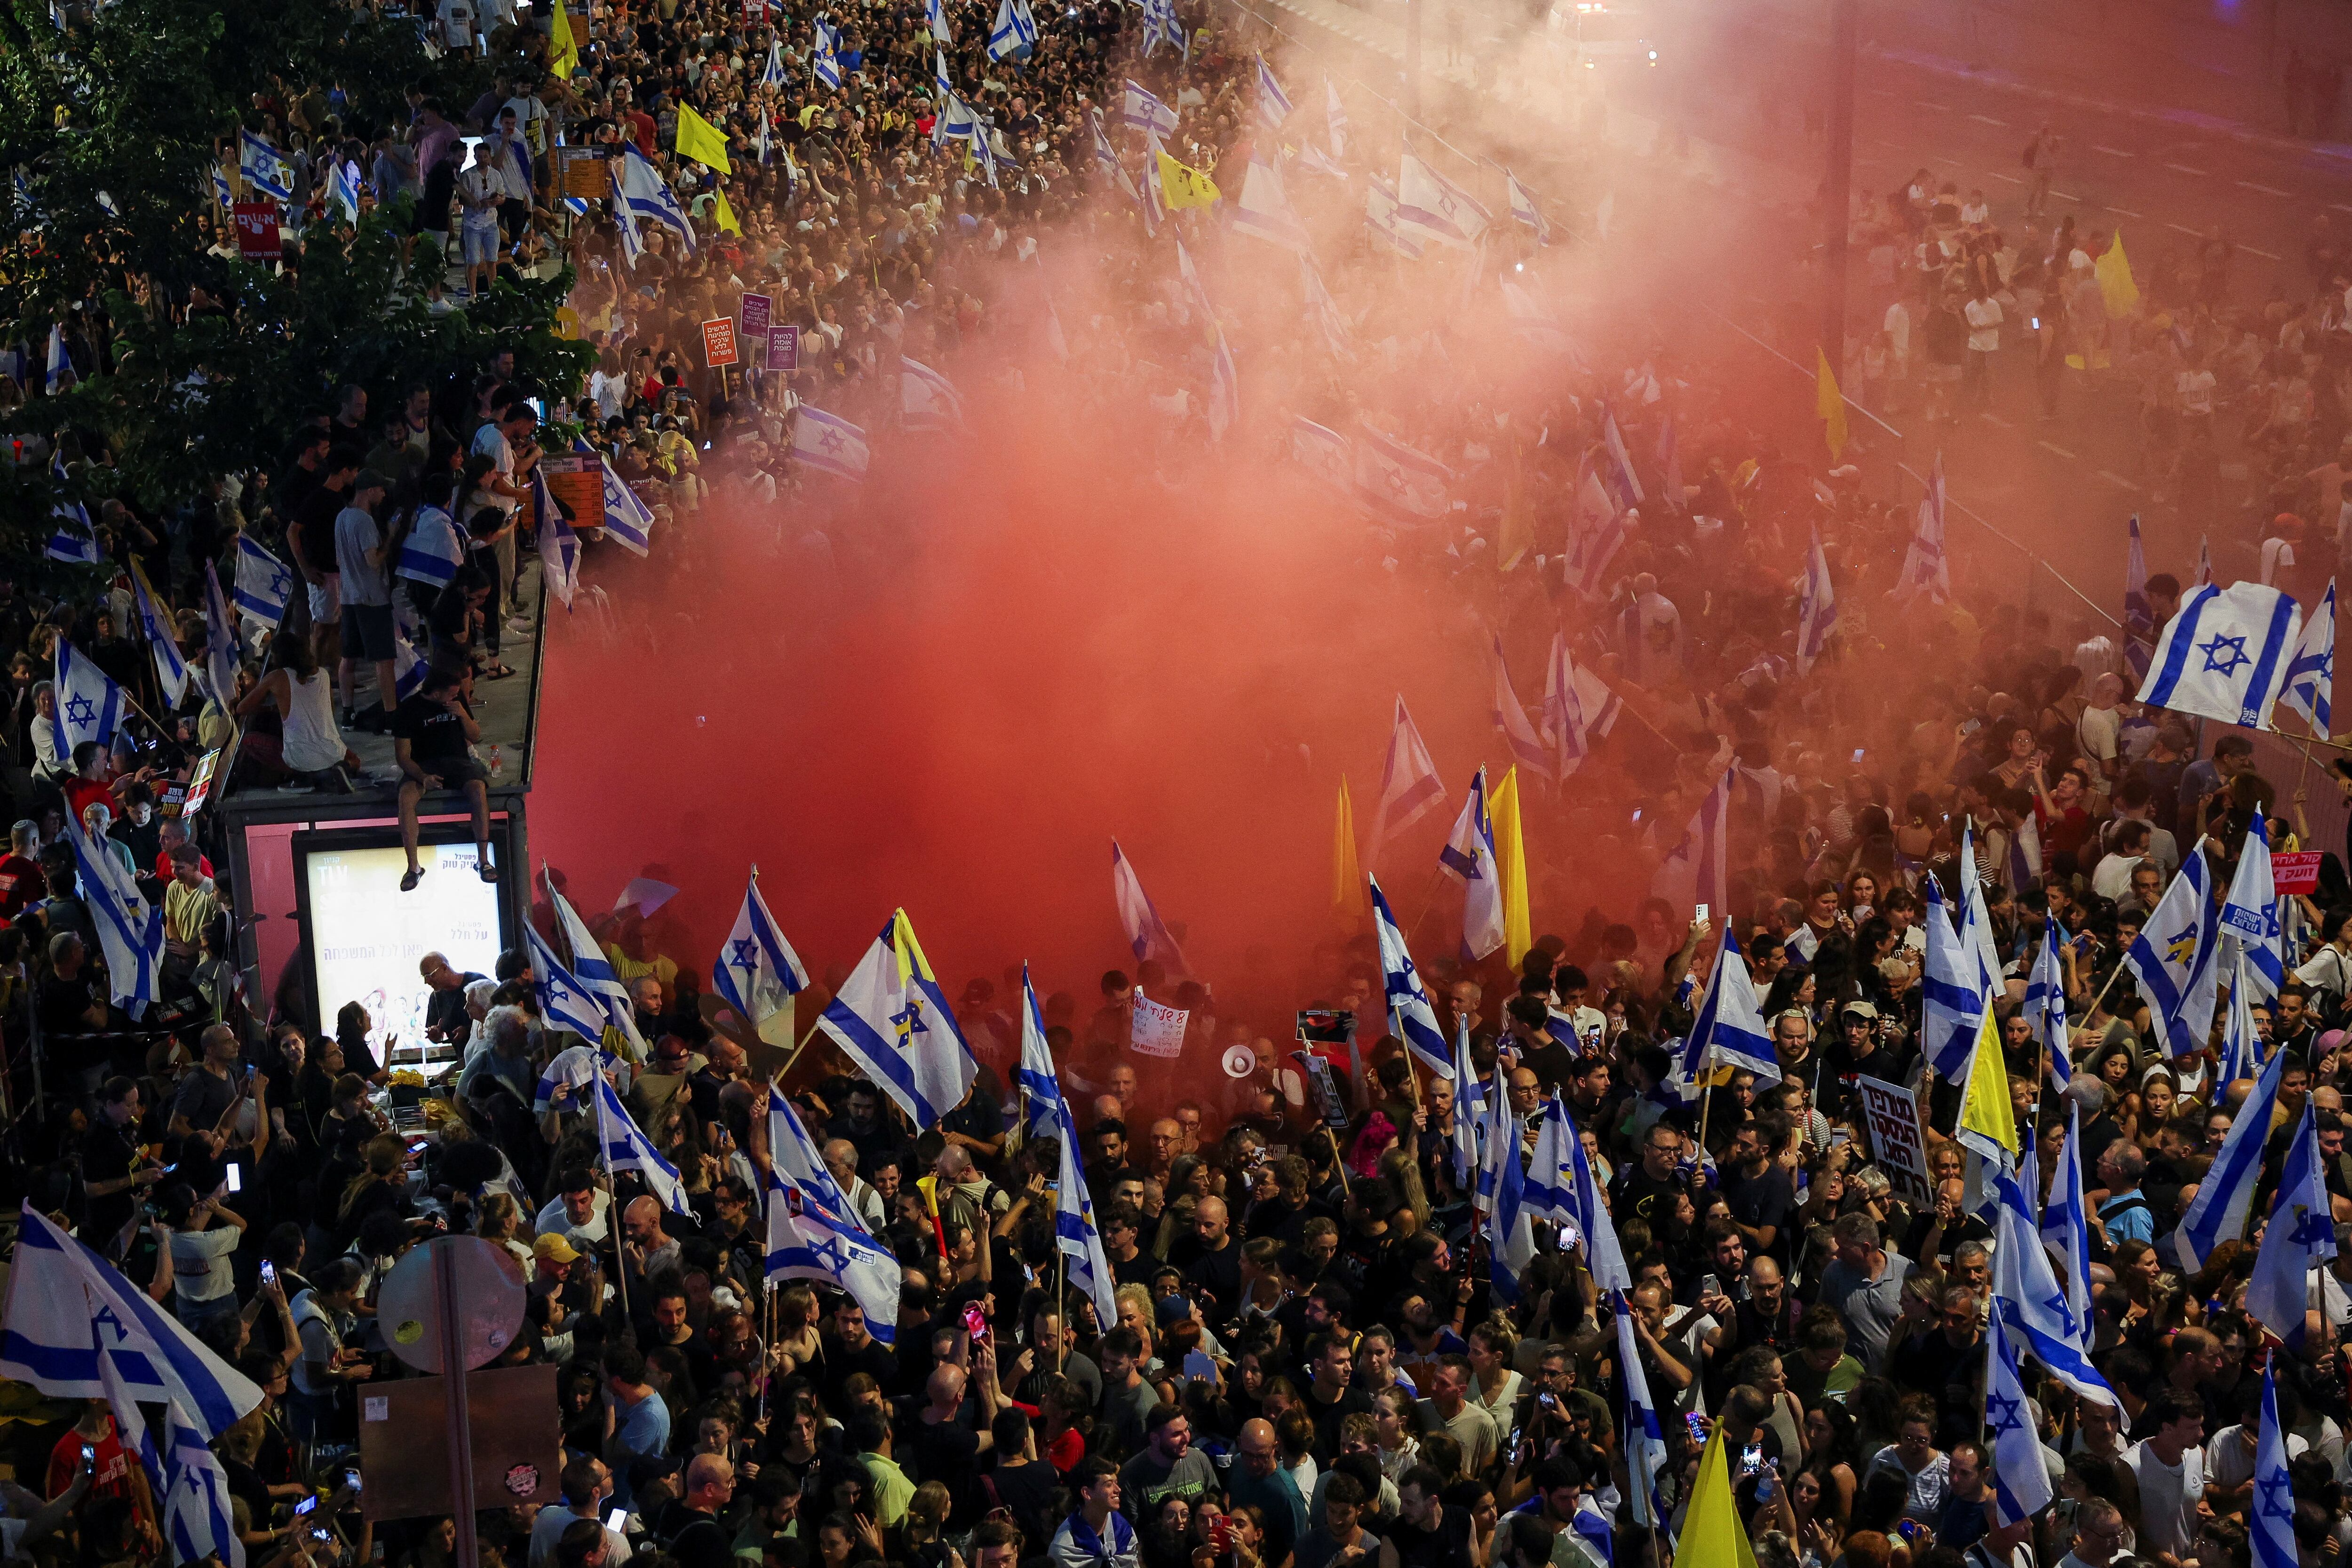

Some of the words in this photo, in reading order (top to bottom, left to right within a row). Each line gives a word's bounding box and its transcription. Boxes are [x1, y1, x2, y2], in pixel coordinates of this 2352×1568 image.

[707, 324, 728, 333] דורשים
[707, 330, 731, 339] מנהיגות
[711, 336, 729, 345] ערכית
[711, 349, 732, 357] פשרות
[2303, 854, 2322, 863] קול
[442, 860, 458, 869] טוק
[317, 865, 349, 886] TLV
[451, 928, 471, 940] חלל
[475, 929, 488, 940] על
[324, 946, 376, 961] המשפחה
[403, 943, 424, 959] פאן
[1176, 1012, 1185, 1024] 8
